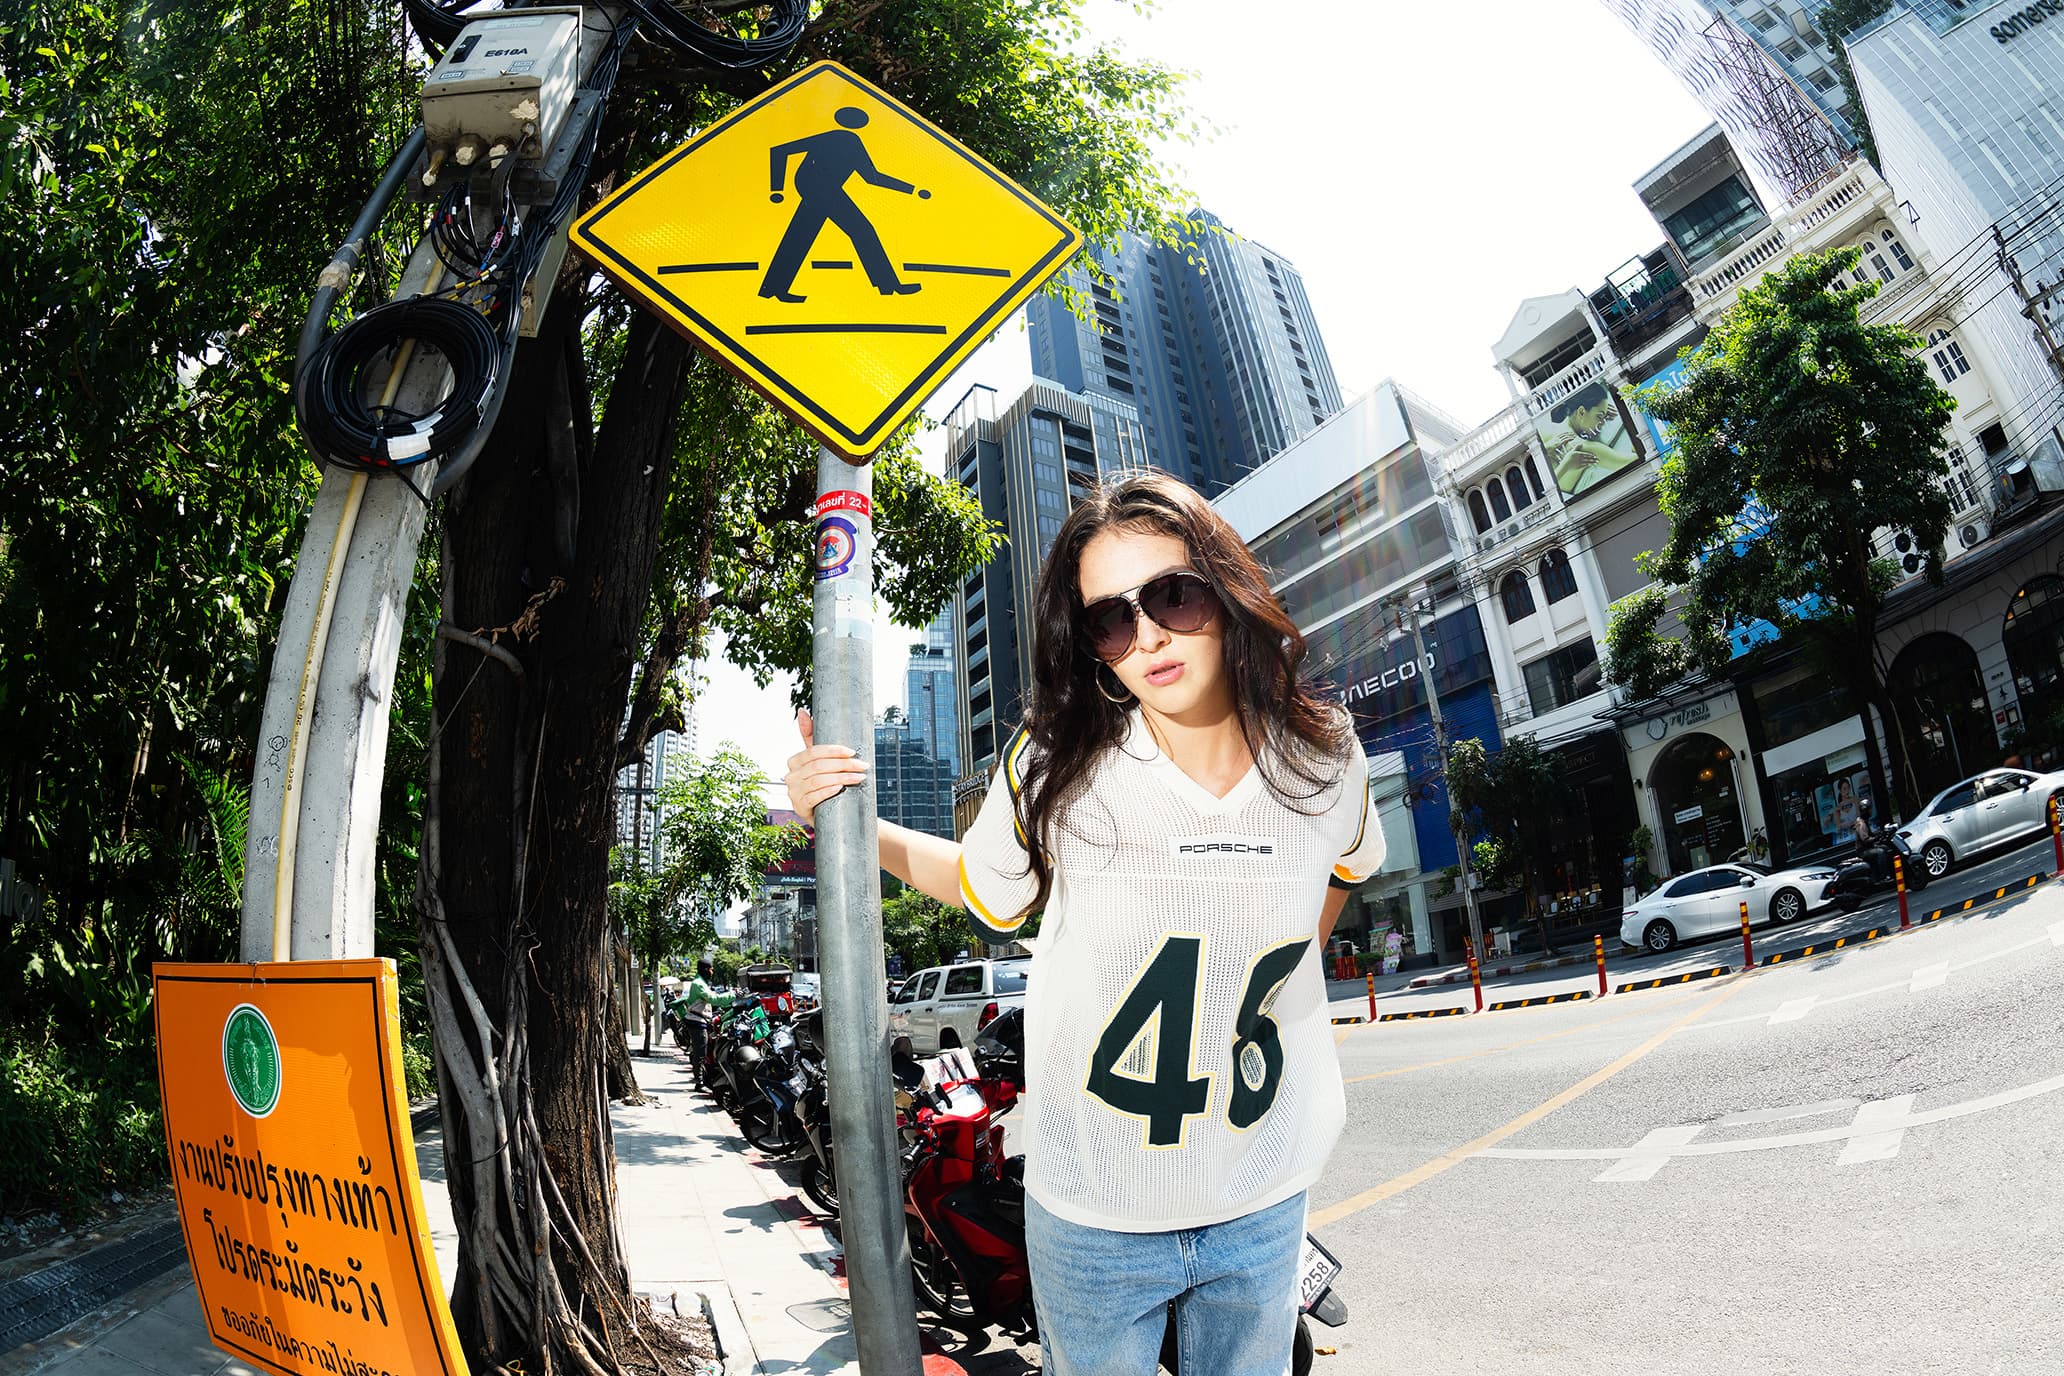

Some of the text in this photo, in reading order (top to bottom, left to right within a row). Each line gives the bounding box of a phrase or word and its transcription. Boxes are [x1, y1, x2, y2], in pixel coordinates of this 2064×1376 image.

[1180, 843, 1272, 854] PORSCHE
[1082, 931, 1314, 1149] 46
[179, 1135, 397, 1236] งานปรับปรุงทางเท้า
[203, 1207, 388, 1327] โปรดระมัดระวัง
